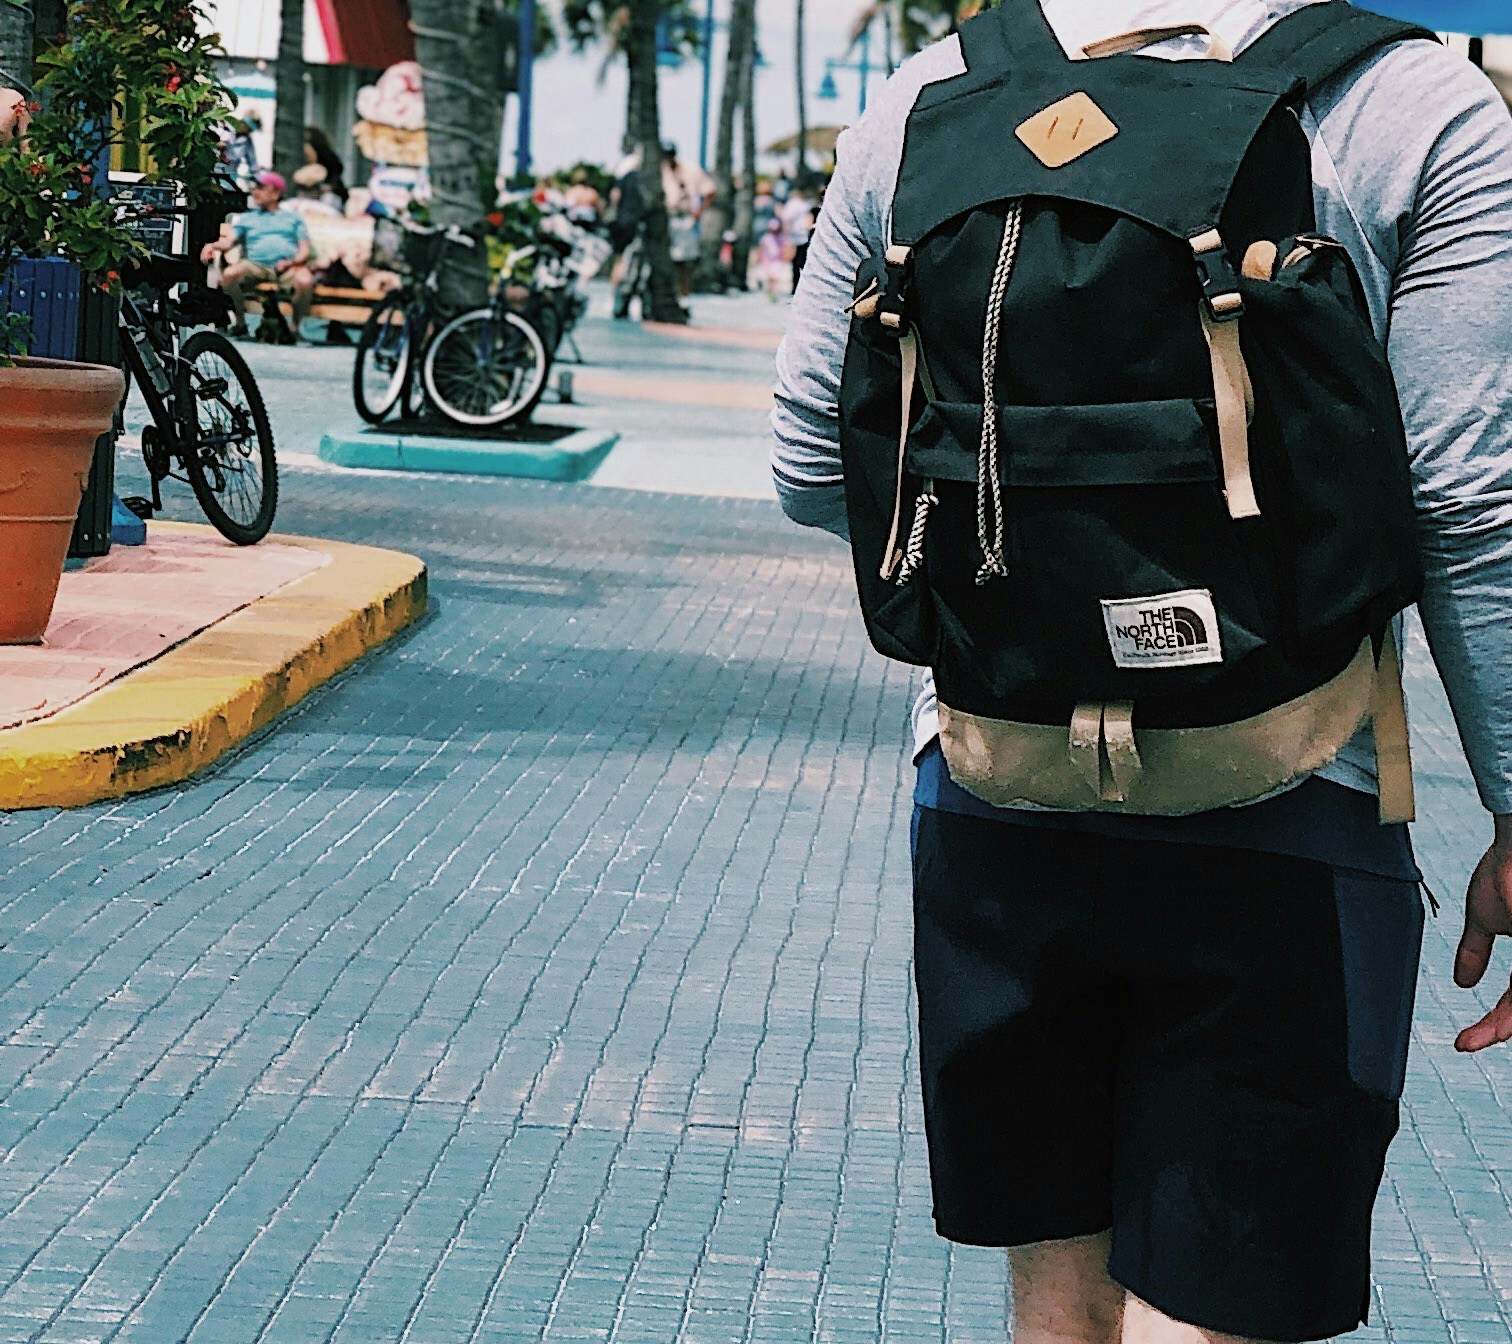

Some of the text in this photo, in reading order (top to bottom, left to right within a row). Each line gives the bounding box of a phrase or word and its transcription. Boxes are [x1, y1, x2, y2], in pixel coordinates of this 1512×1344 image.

[1138, 607, 1172, 625] THE
[1115, 621, 1175, 639] NORTH
[1135, 635, 1177, 651] FACE
